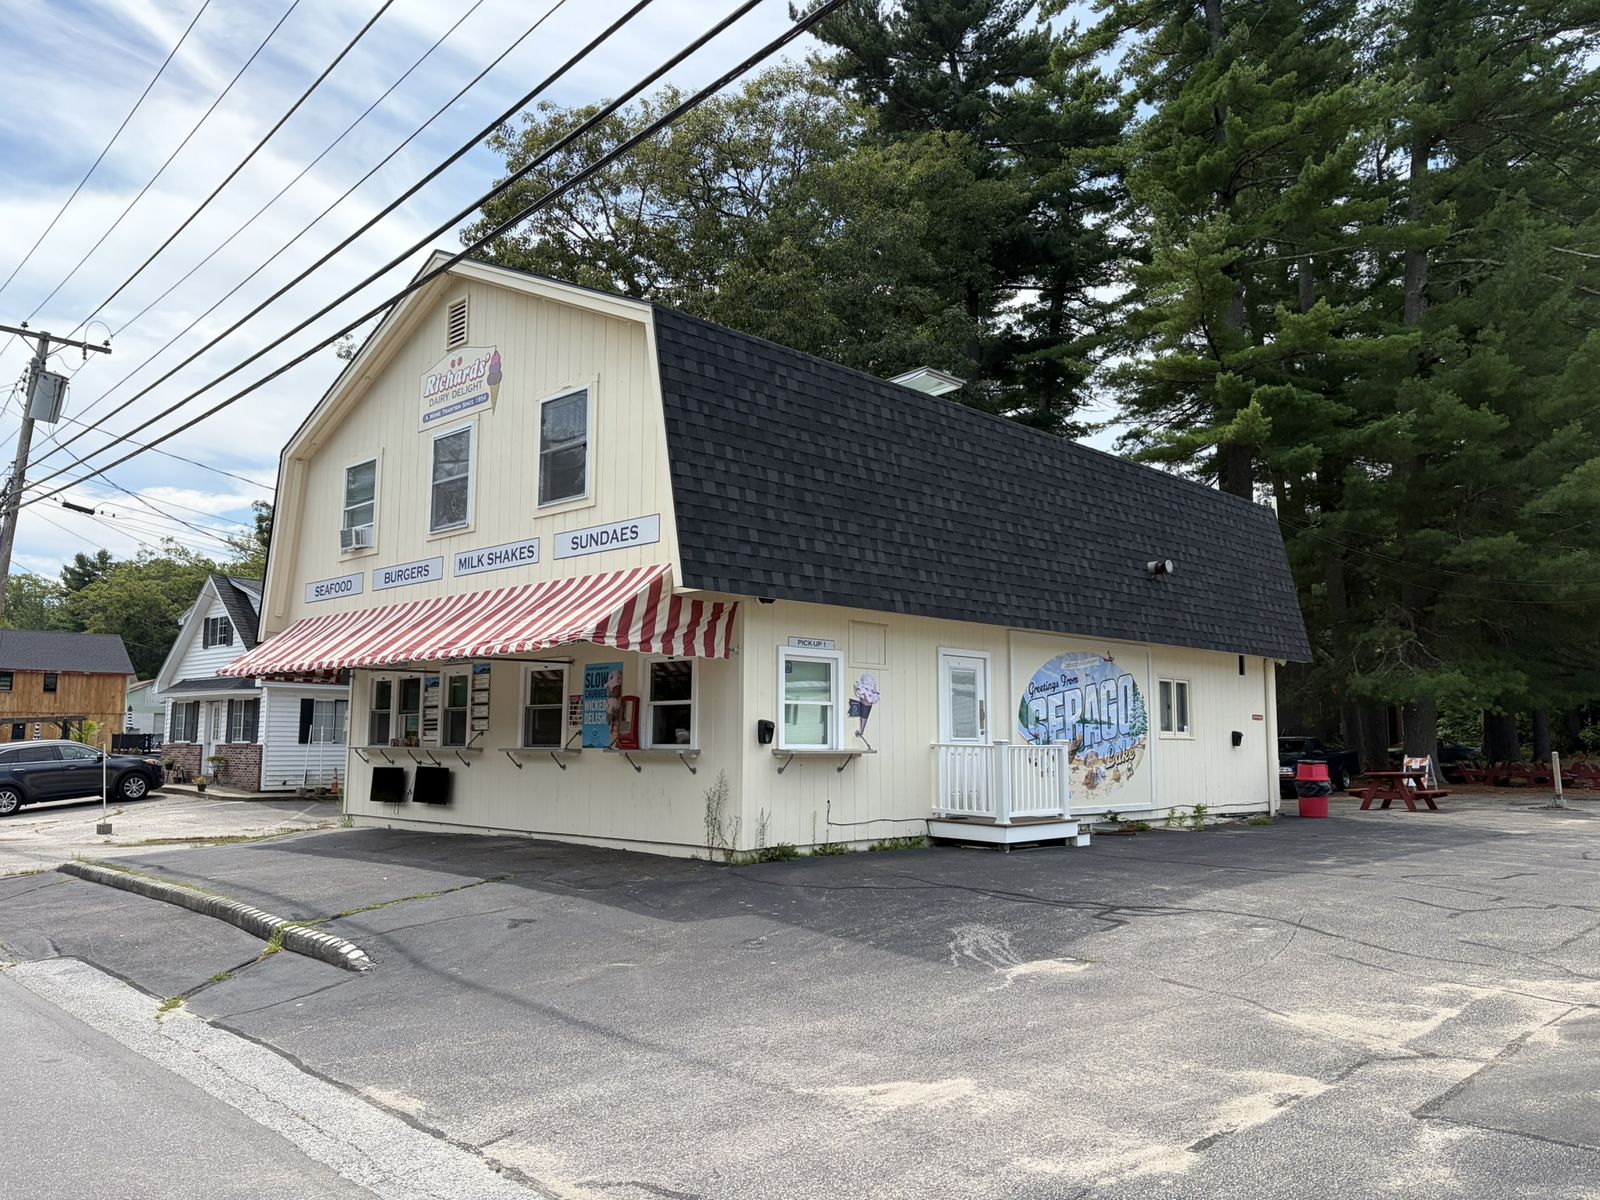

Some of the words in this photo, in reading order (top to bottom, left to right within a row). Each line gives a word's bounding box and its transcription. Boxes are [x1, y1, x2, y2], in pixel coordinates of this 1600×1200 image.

[429, 392, 449, 407] DAIRY
[452, 380, 483, 399] DELIGHT
[571, 525, 639, 551] SUNDAES
[458, 550, 485, 571] MILK
[487, 545, 536, 567] SHAKES
[384, 564, 430, 585] BURGERS
[314, 580, 353, 598] SEAFOOD
[585, 671, 609, 688] SLOW
[1028, 681, 1059, 698] Greetings
[1061, 674, 1078, 687] From
[1105, 739, 1136, 770] Lake
